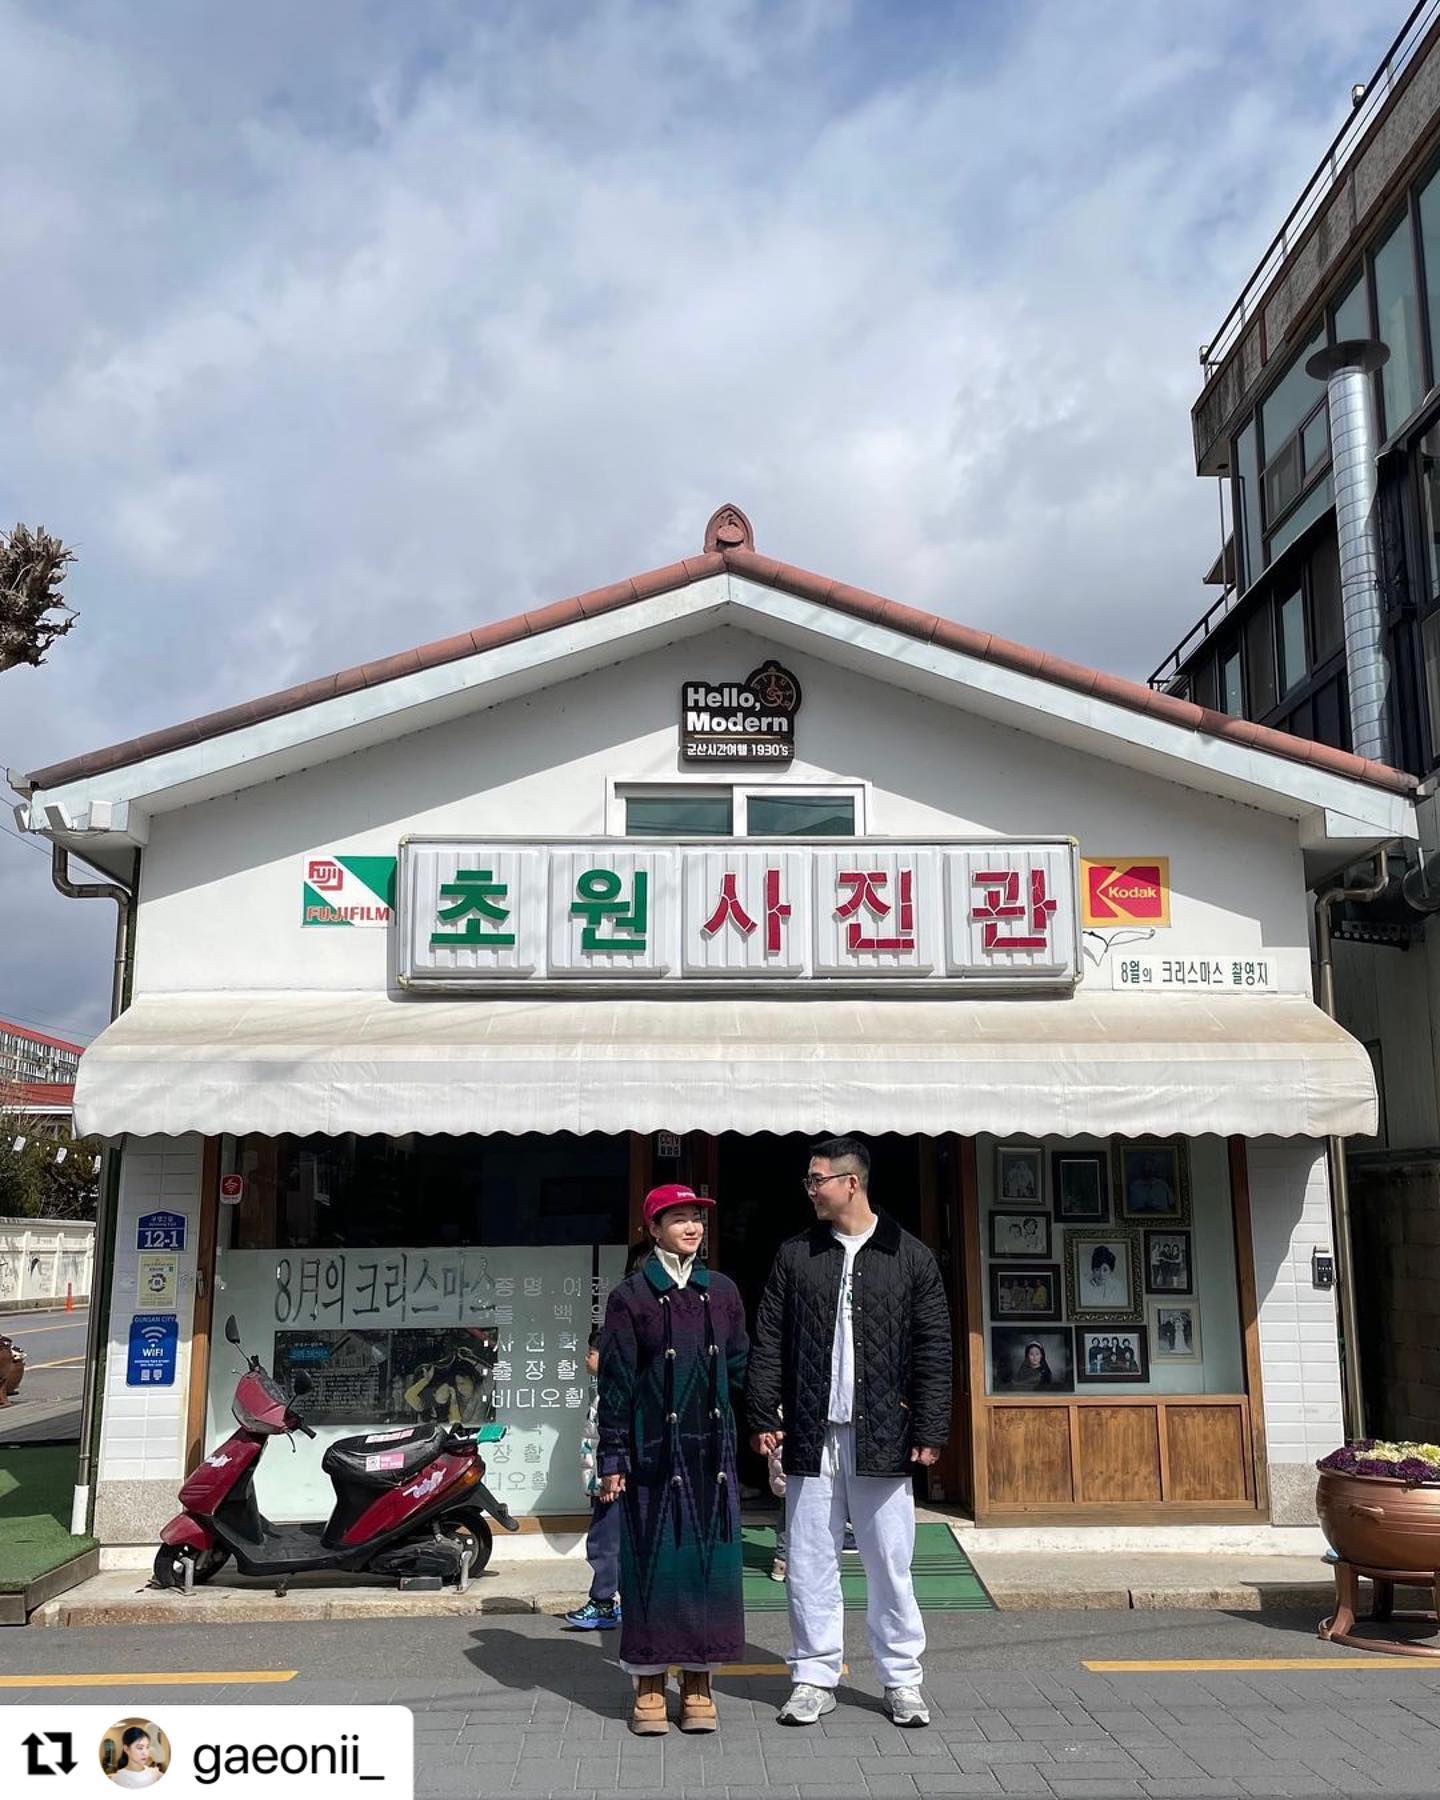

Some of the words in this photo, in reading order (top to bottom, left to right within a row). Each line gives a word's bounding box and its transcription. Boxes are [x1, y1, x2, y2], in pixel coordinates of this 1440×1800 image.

[687, 687, 760, 711] Hello,
[687, 711, 788, 731] Modern
[687, 743, 747, 756] 군산시간여행
[751, 743, 788, 756] 1930's
[1108, 886, 1157, 899] Kodak
[306, 905, 390, 921] FUJIFILM
[431, 868, 1057, 953] 초원사진관
[1120, 961, 1152, 984] 8월의
[1162, 961, 1223, 985] 크리스마스
[1232, 961, 1268, 986] 촬영지
[144, 1230, 178, 1248] 12-1
[353, 1252, 496, 1323] 크리스마스
